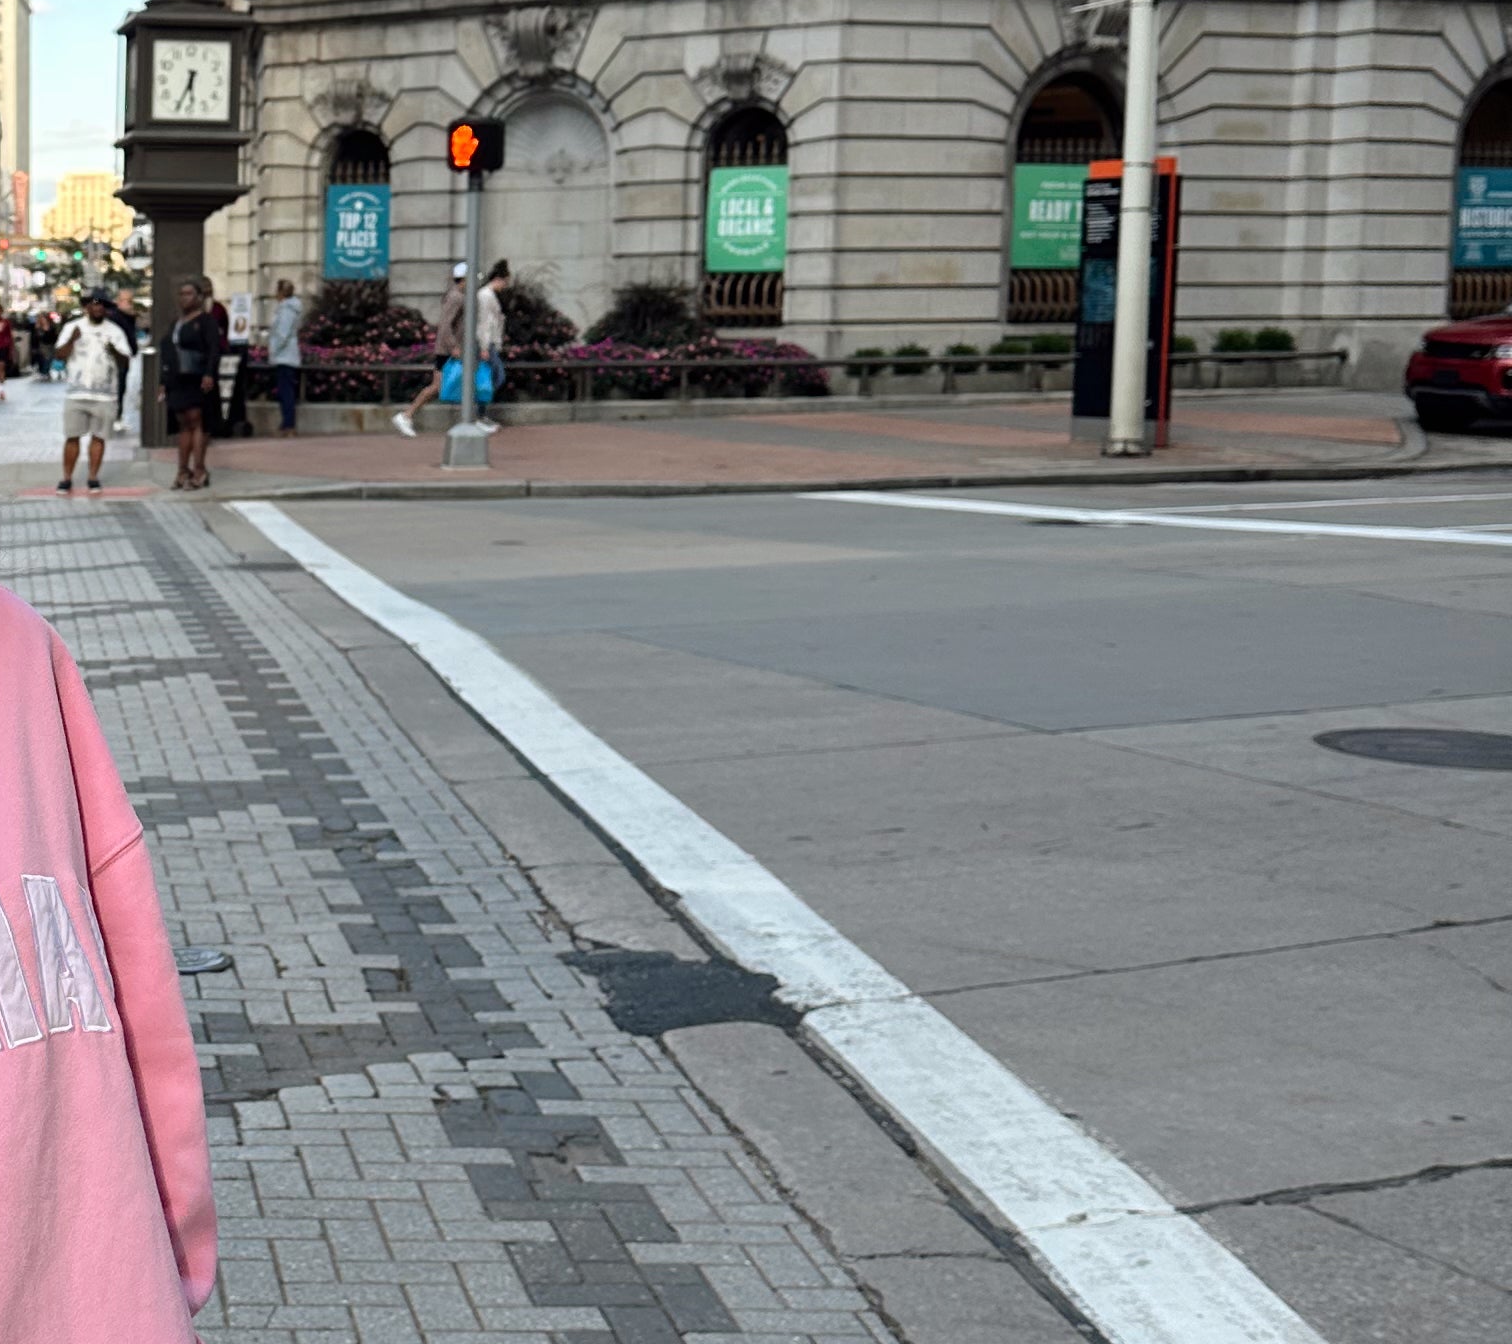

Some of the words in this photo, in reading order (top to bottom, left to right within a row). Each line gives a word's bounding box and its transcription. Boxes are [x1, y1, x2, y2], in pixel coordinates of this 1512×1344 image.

[719, 197, 760, 216] LOCAL
[1028, 199, 1073, 222] READY
[338, 211, 361, 230] TOP
[363, 212, 378, 230] 12
[717, 217, 776, 237] ORGANIC
[336, 230, 378, 248] PLACES
